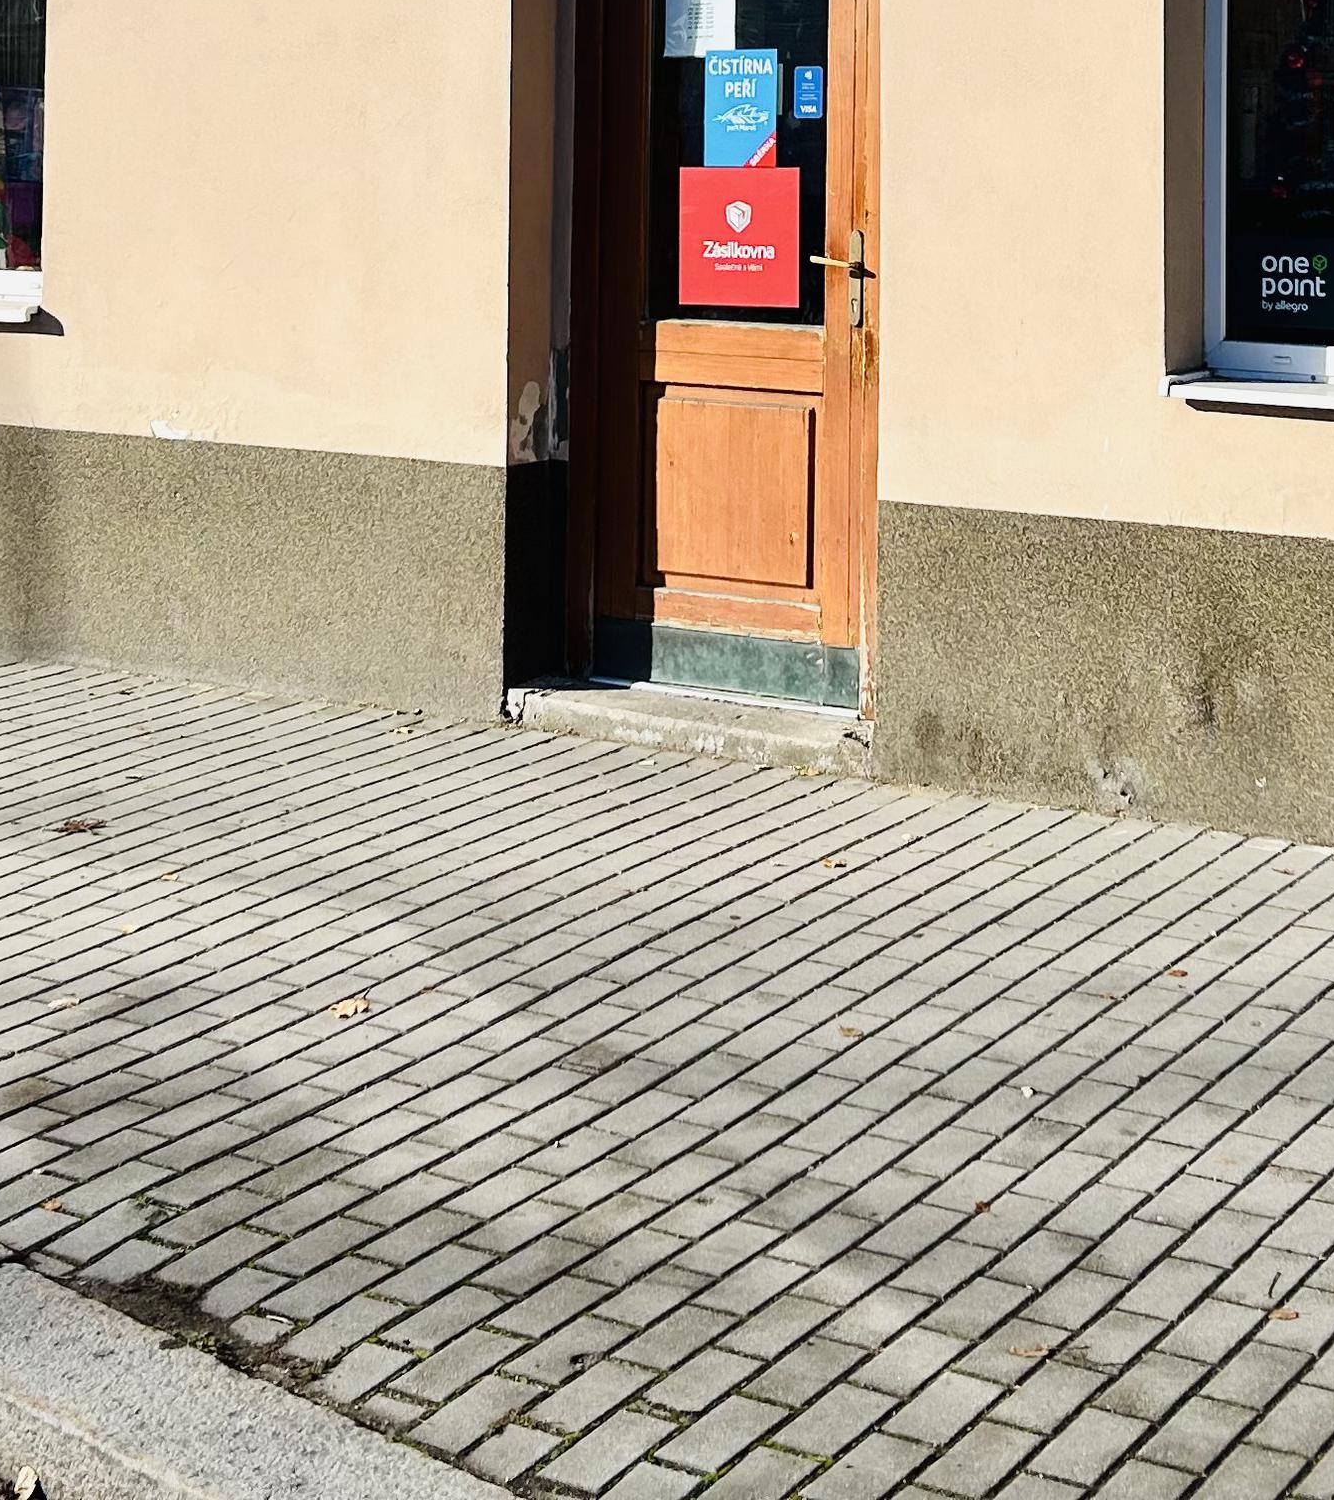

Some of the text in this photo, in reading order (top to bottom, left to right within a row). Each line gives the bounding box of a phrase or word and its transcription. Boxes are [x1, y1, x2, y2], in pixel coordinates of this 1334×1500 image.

[708, 55, 774, 76] ČISTÍRNA
[724, 78, 758, 99] PEŘÍ
[799, 104, 818, 114] VISA
[702, 240, 776, 260] Zásilkovna
[1261, 255, 1310, 274] one
[1261, 276, 1327, 298] point
[1261, 300, 1309, 313] by allegro
